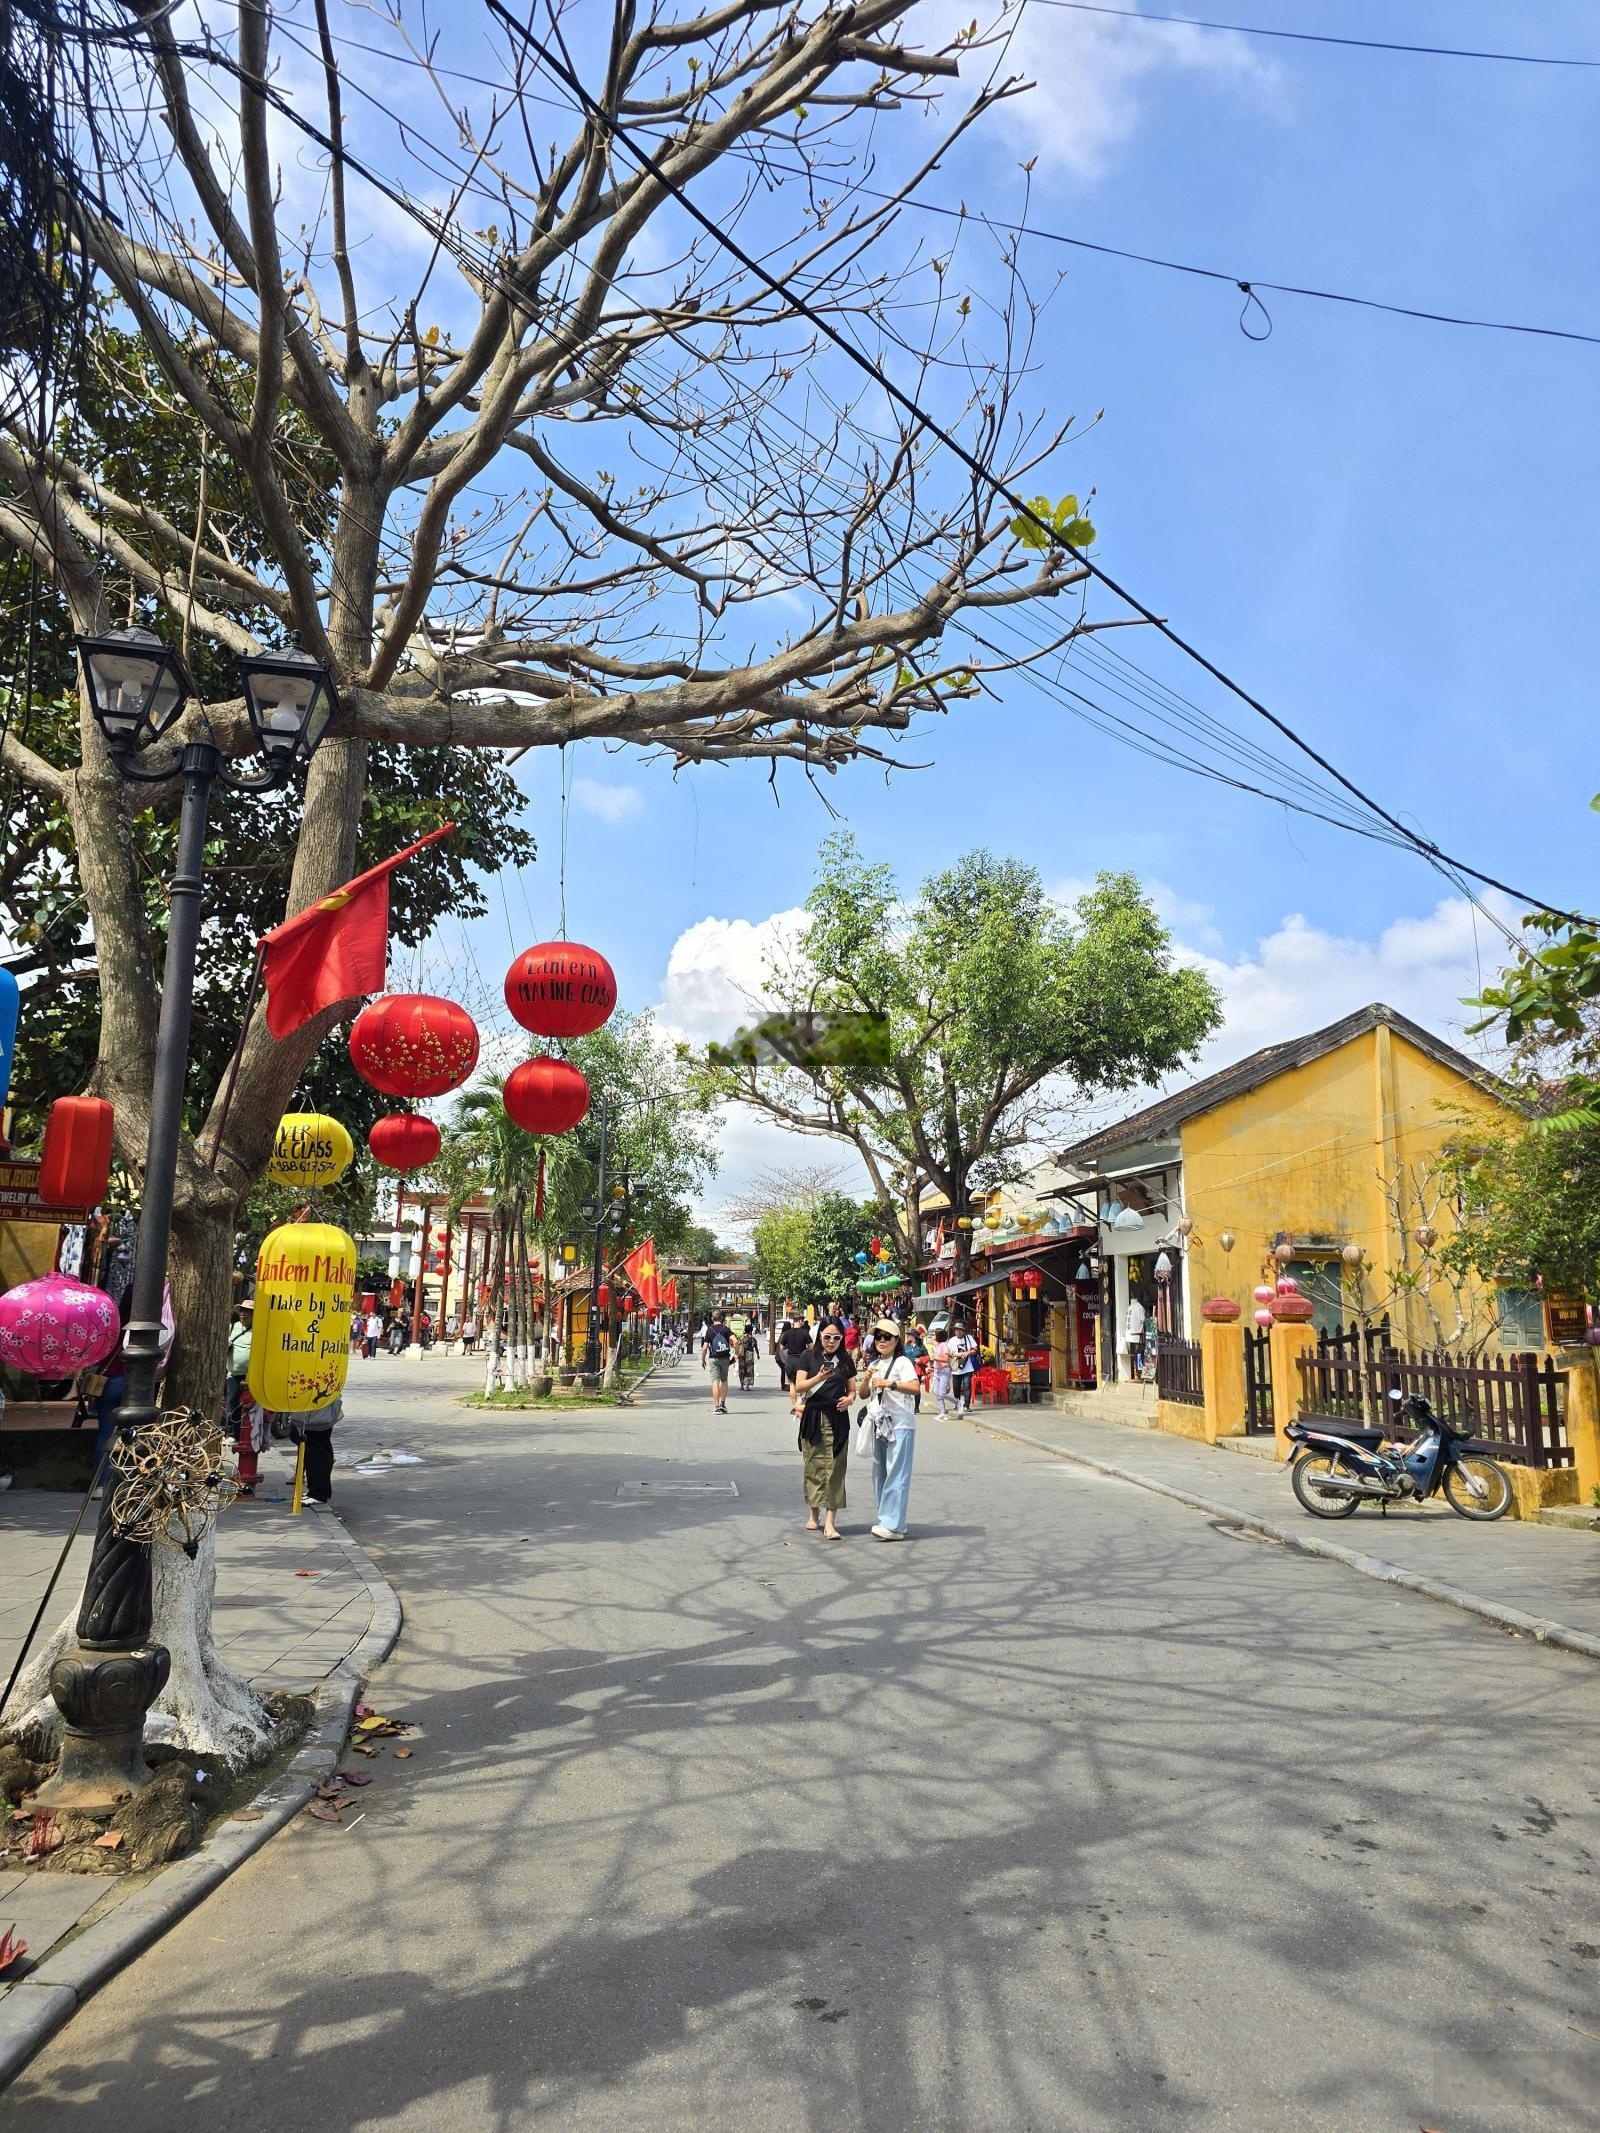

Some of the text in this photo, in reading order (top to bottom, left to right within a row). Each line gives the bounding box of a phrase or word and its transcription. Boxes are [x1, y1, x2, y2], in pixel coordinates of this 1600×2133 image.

[527, 958, 597, 980] Lantern
[581, 983, 610, 1008] CLASS
[281, 1125, 315, 1141] VER
[291, 1140, 333, 1160] CLASS
[257, 1254, 310, 1282] Lantern
[270, 1294, 302, 1312] Make
[309, 1292, 326, 1320] by
[307, 1319, 320, 1334] &
[281, 1333, 315, 1353] Hand
